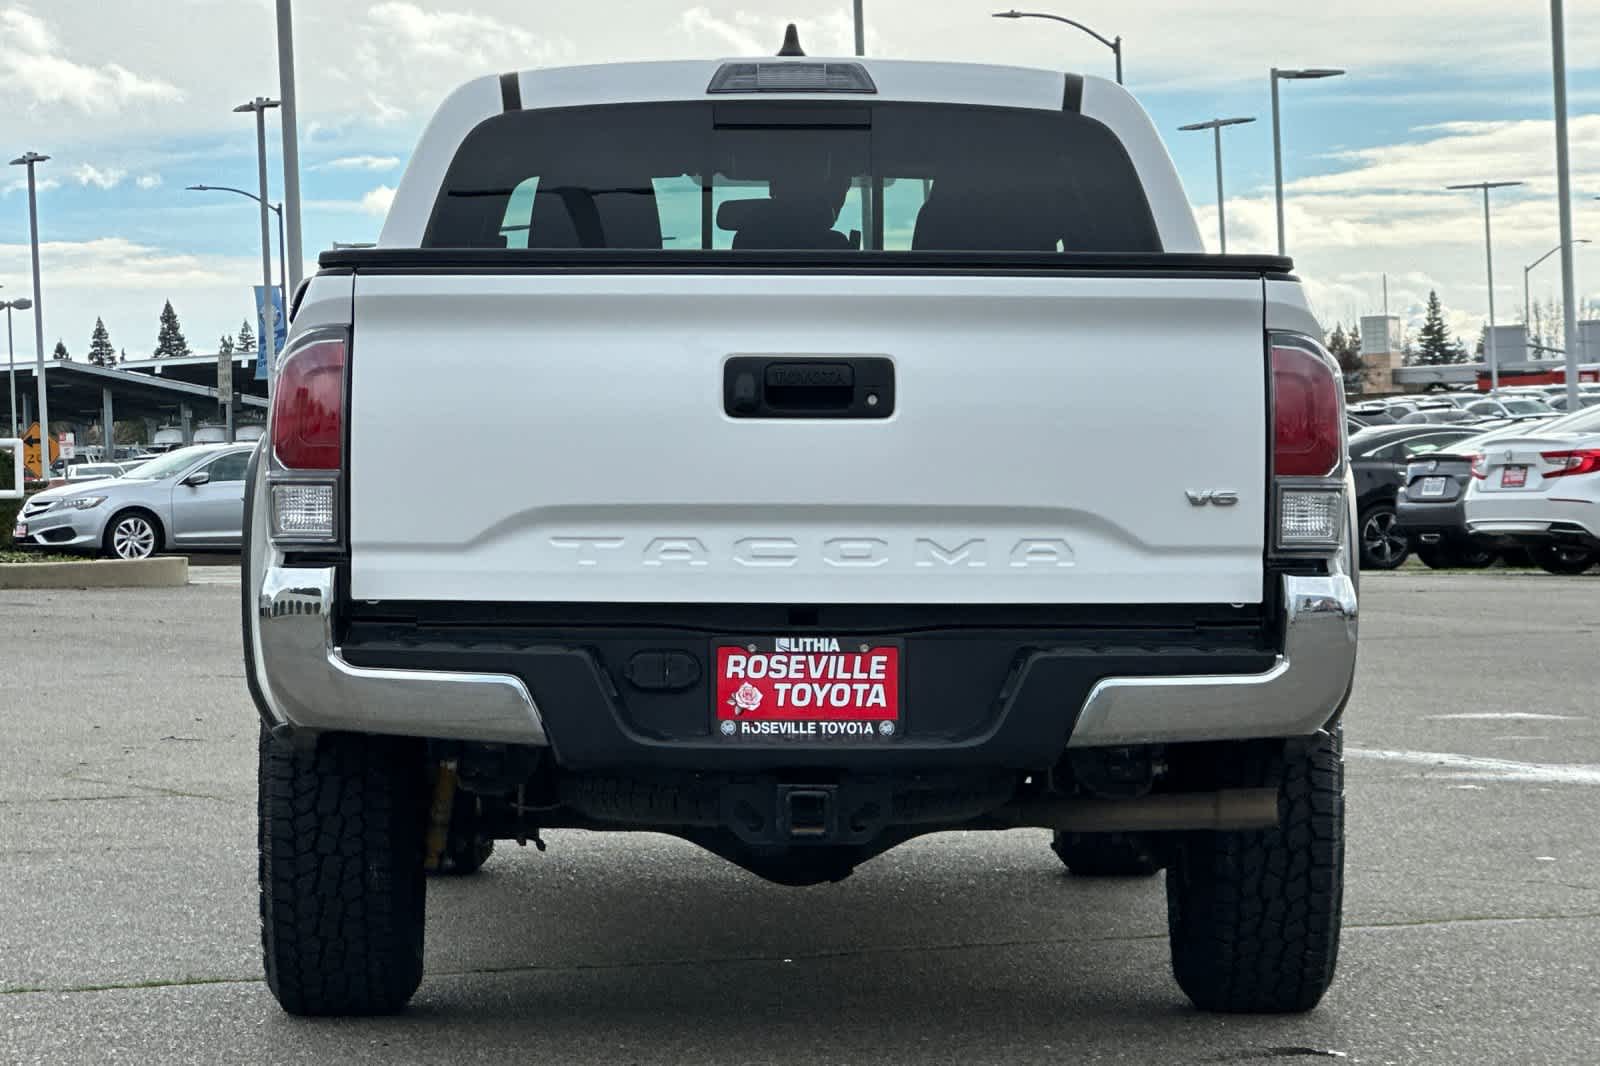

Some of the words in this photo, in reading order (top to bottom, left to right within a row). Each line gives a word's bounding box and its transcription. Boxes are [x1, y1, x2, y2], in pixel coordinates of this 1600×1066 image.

[1184, 488, 1239, 506] V6
[549, 536, 1076, 567] TACOMA
[790, 637, 840, 652] LITHIA
[726, 654, 887, 680] ROSEVILLE
[774, 682, 887, 708] TOYOTA
[741, 721, 817, 735] ROSEVILLE
[819, 721, 874, 735] TOYOTA
